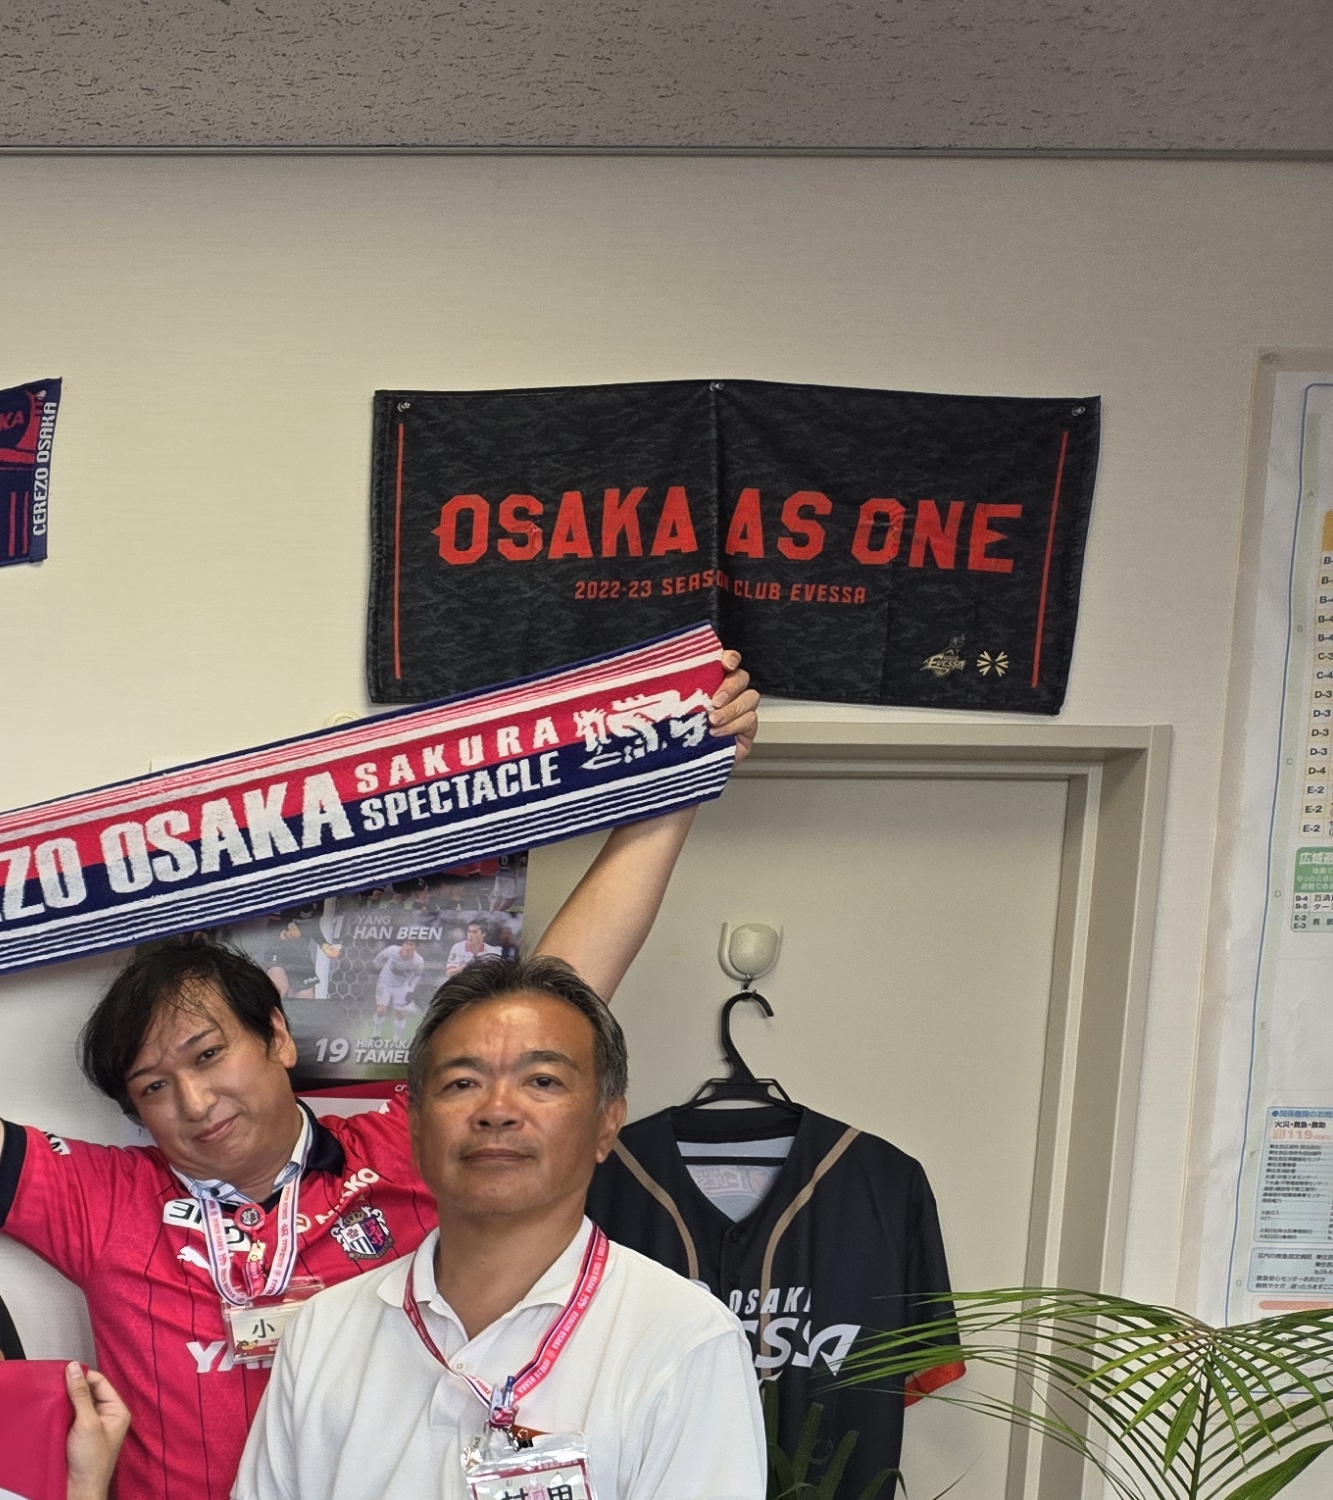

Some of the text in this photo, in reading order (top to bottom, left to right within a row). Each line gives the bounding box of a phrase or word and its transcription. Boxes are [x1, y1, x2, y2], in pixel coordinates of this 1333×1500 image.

[32, 401, 57, 536] CEREZO OSAKA
[432, 486, 1023, 575] OSAKA AS ONE
[574, 568, 867, 604] 2022-23 SEASON CLUB EVESSA
[1314, 690, 1332, 698] D-3
[354, 715, 560, 794] SAKURA
[1308, 767, 1326, 775] D-4
[360, 751, 561, 832] SPECTACLE
[1307, 786, 1325, 794] E-2
[1305, 805, 1323, 813] E-2
[99, 771, 357, 895] OSAKA
[1303, 825, 1321, 833] E-2
[358, 915, 392, 925] YANG
[353, 926, 443, 940] HAN BEEN
[315, 1038, 350, 1063] 19
